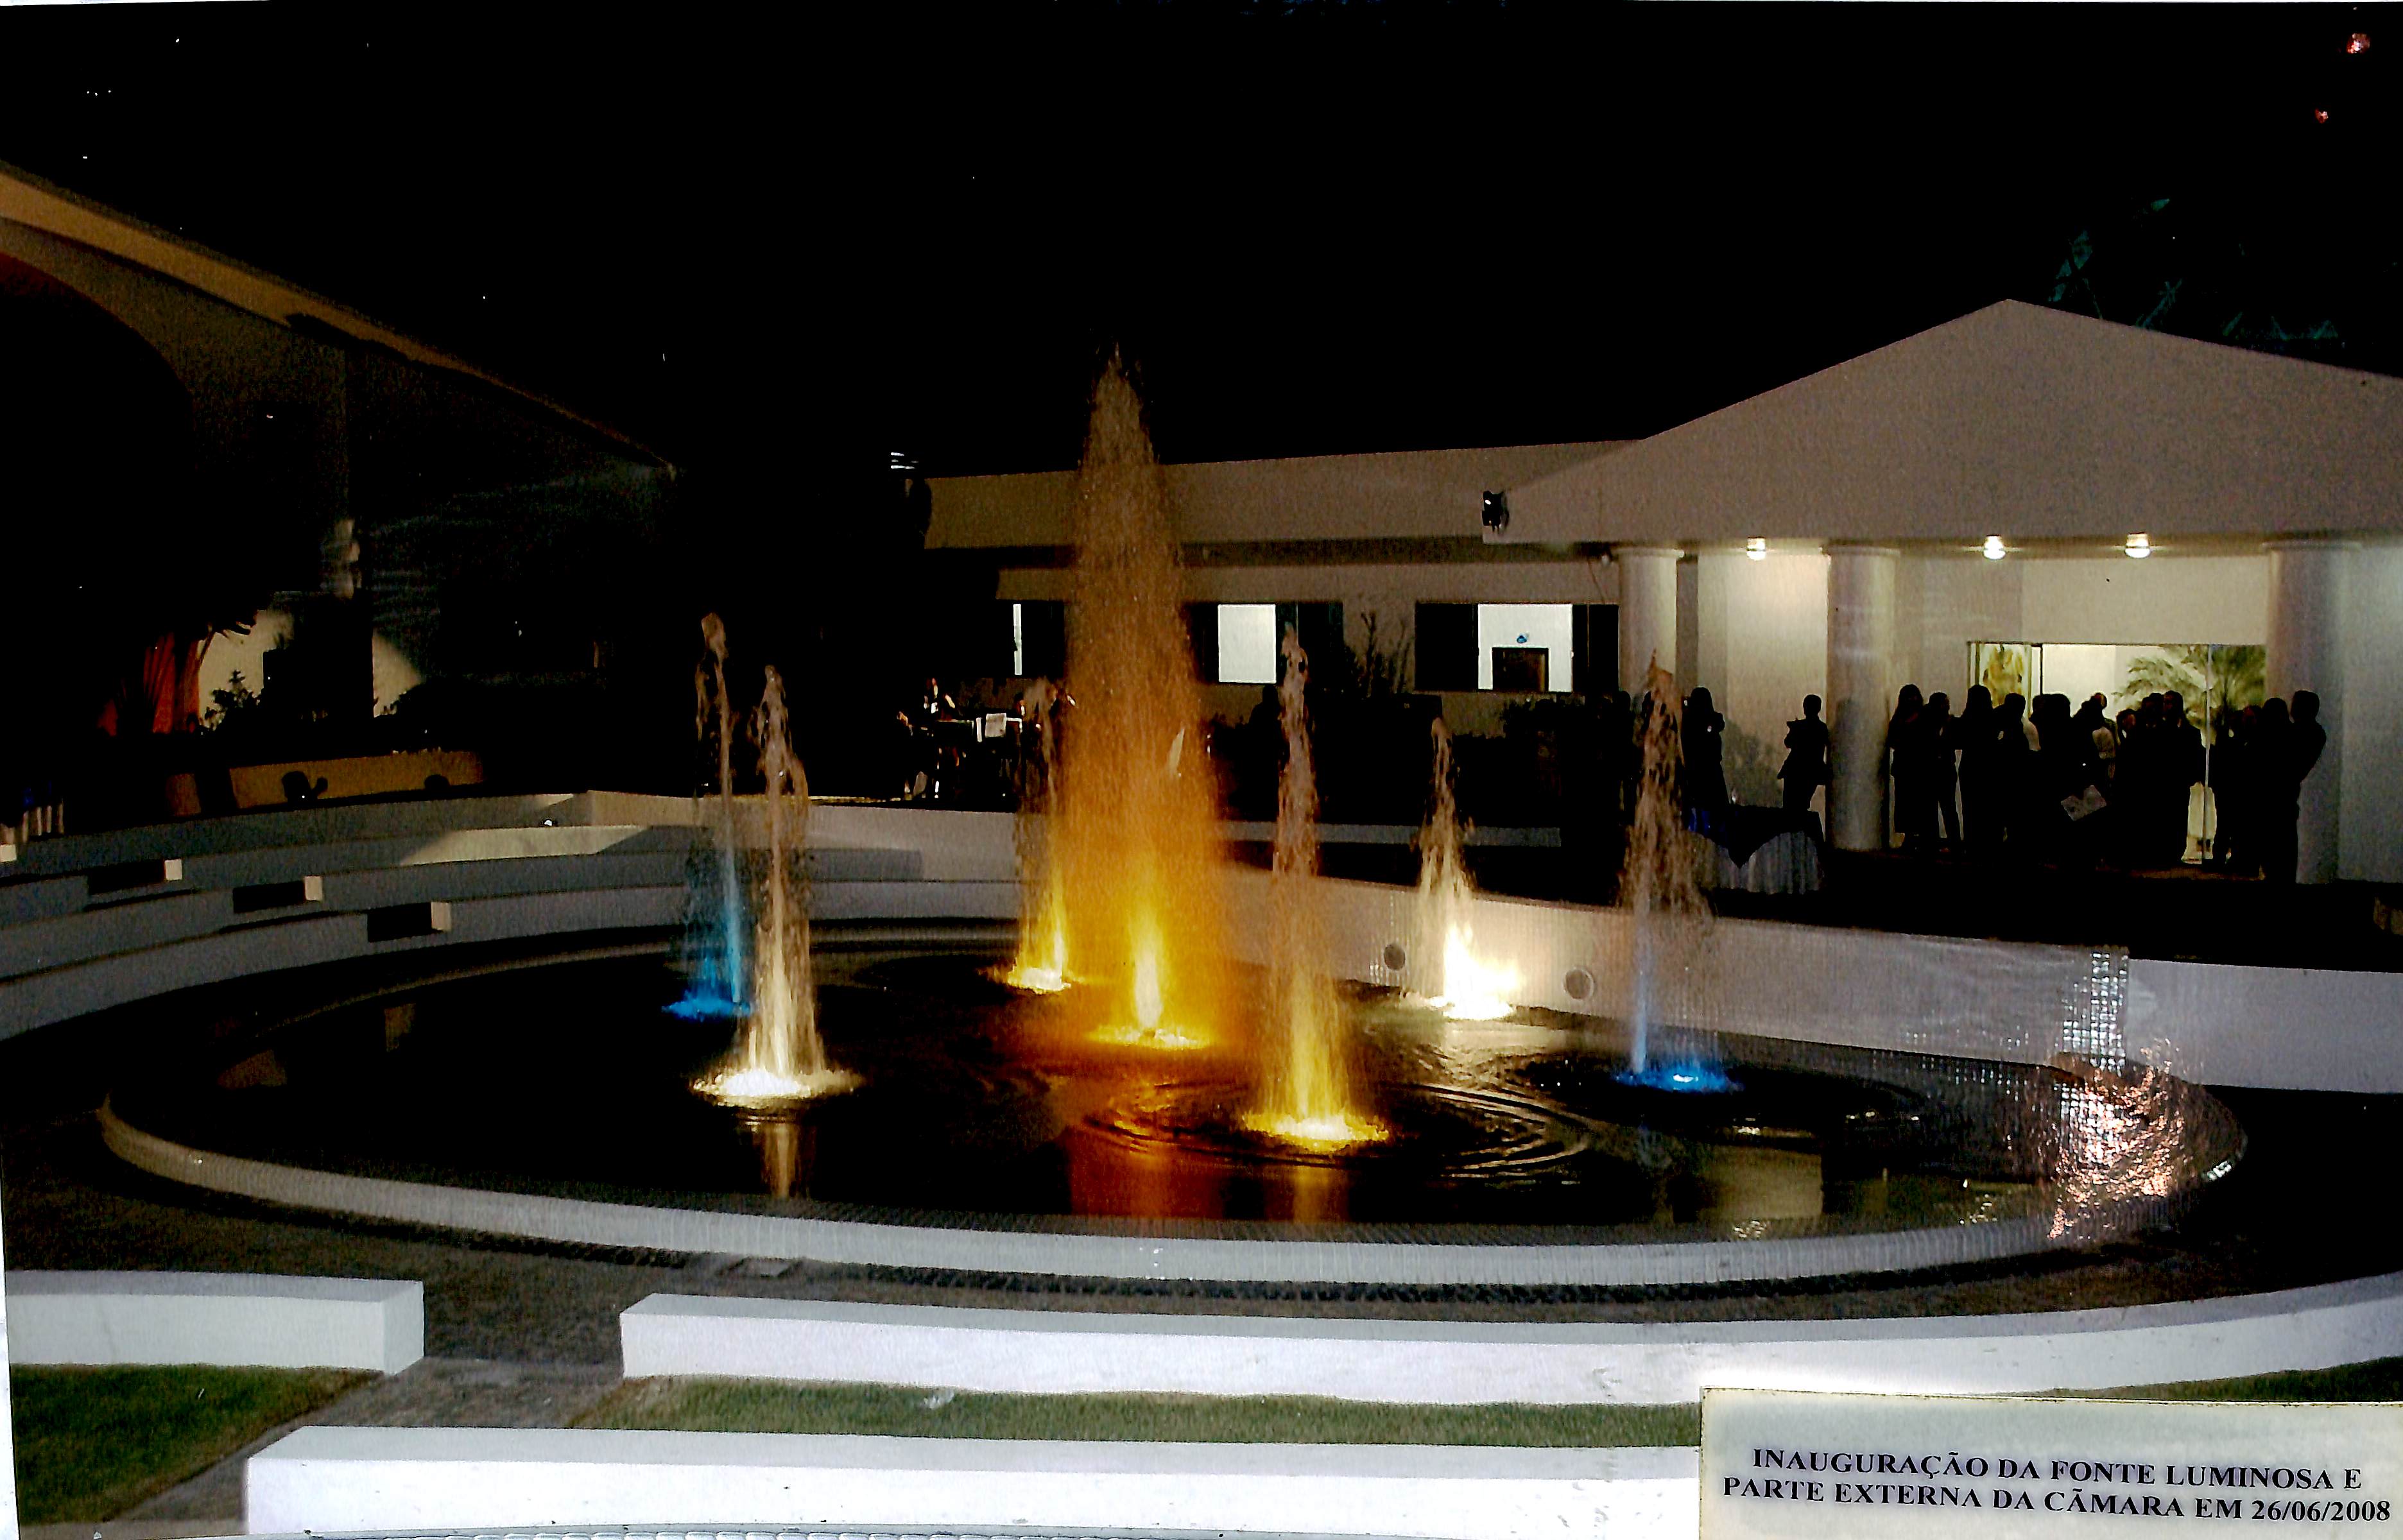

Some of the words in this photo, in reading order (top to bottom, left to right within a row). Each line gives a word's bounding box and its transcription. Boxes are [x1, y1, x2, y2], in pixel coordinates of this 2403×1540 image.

[1753, 1448, 1988, 1480] INAUGURAÇÃO
[1998, 1459, 2040, 1479] DA
[2051, 1460, 2155, 1484] FONTE
[2166, 1465, 2334, 1489] LUMINOSA
[2343, 1469, 2362, 1489] E
[1723, 1477, 1824, 1502] PARTE
[1835, 1483, 1982, 1507] EXTERNA
[1993, 1489, 2035, 1510] DA
[2195, 1498, 2243, 1519] EM
[2252, 1500, 2390, 1521] 26/06/2008
